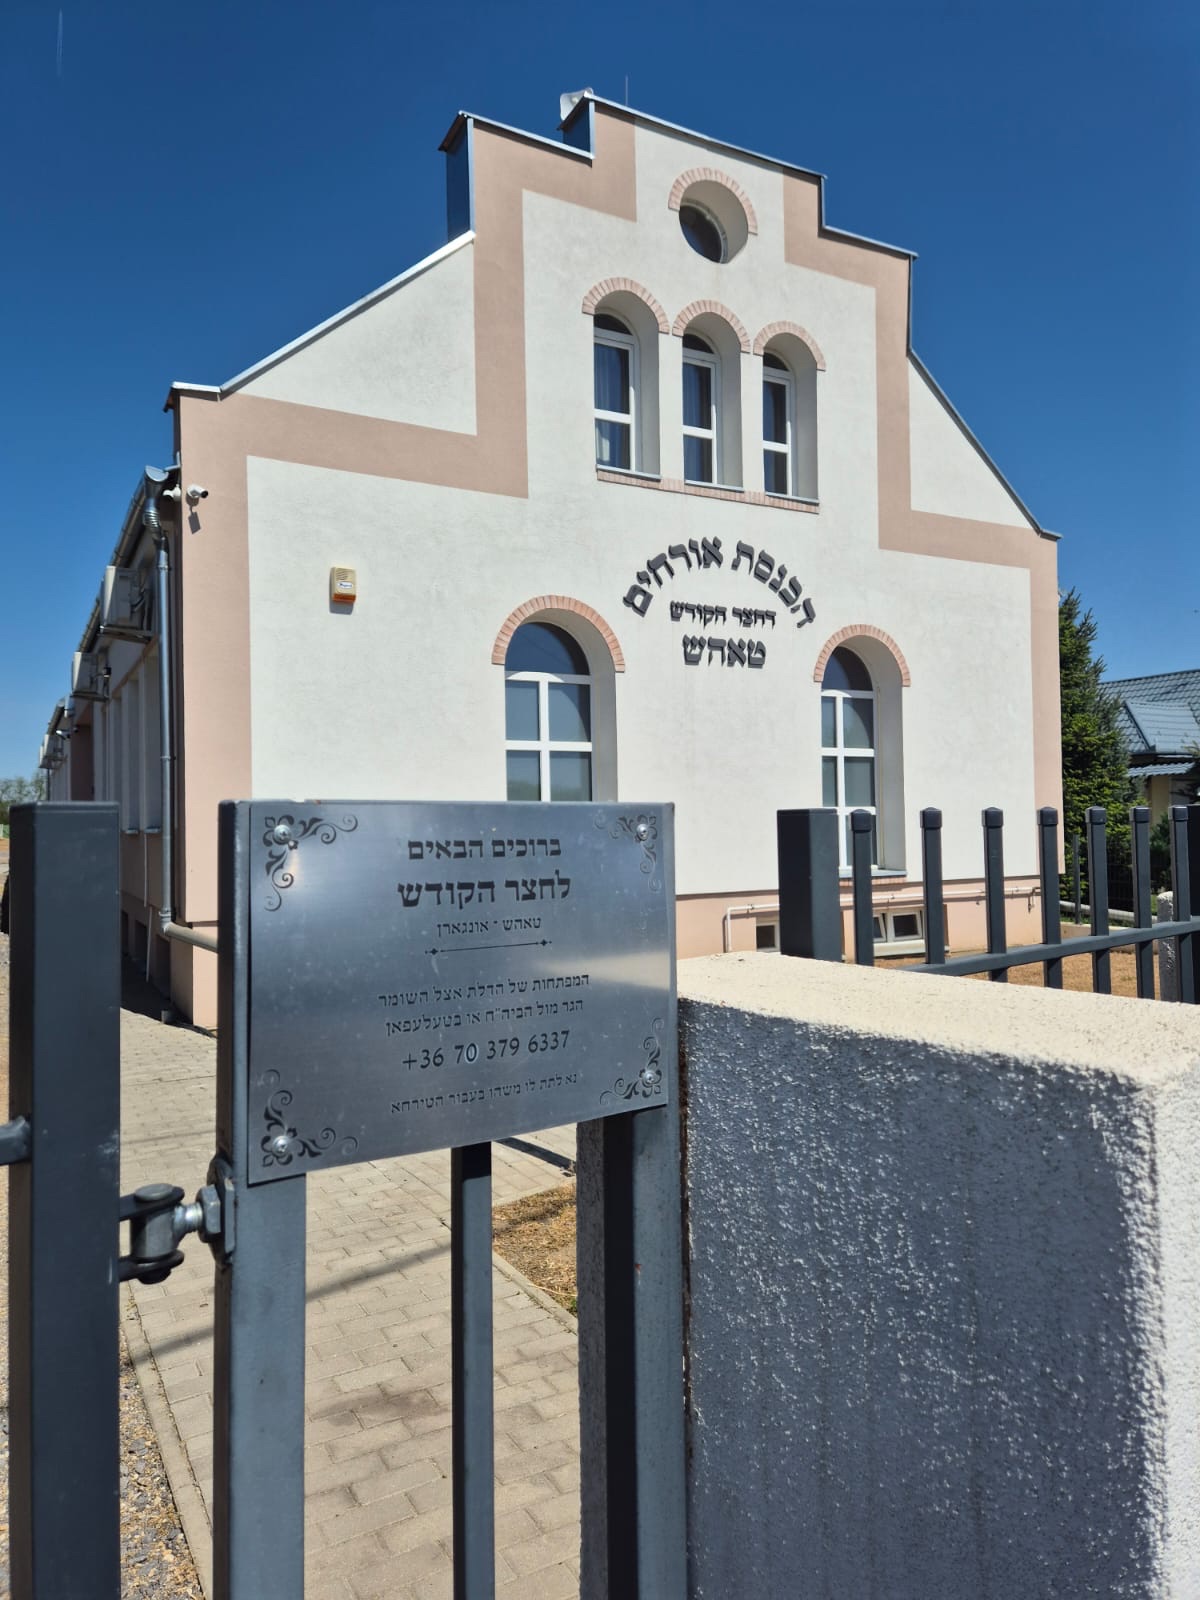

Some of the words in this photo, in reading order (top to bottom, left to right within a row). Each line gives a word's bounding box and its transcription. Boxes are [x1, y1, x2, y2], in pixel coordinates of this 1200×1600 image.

[623, 536, 723, 618] אורחים
[731, 540, 816, 628] הכנסת
[669, 600, 727, 629] הקודש
[731, 605, 776, 629] דחצר
[682, 633, 767, 668] טאהש
[408, 840, 483, 860] הבאים
[491, 838, 561, 858] ברוכים
[505, 869, 571, 901] לחצר
[397, 880, 495, 910] הקודש
[437, 921, 489, 938] אונגארן
[502, 917, 542, 931] טאהש
[467, 982, 504, 999] הדלת
[508, 978, 528, 994] של
[532, 974, 589, 992] המפתחות
[378, 991, 429, 1007] השומר
[433, 987, 463, 1002] אצל
[536, 1000, 558, 1017] מול
[562, 999, 583, 1013] הגר
[385, 1013, 462, 1037] בטעלעפאן
[466, 1013, 481, 1025] או
[402, 1047, 444, 1071] +36
[454, 1043, 478, 1063] 70
[487, 1037, 520, 1060] 379
[528, 1030, 570, 1054] 6337
[525, 1079, 537, 1092] לו
[539, 1073, 563, 1090] לתת
[565, 1073, 577, 1086] נא
[448, 1088, 485, 1104] בעבור
[489, 1083, 521, 1099] משהו
[391, 1095, 444, 1114] הטירחא
